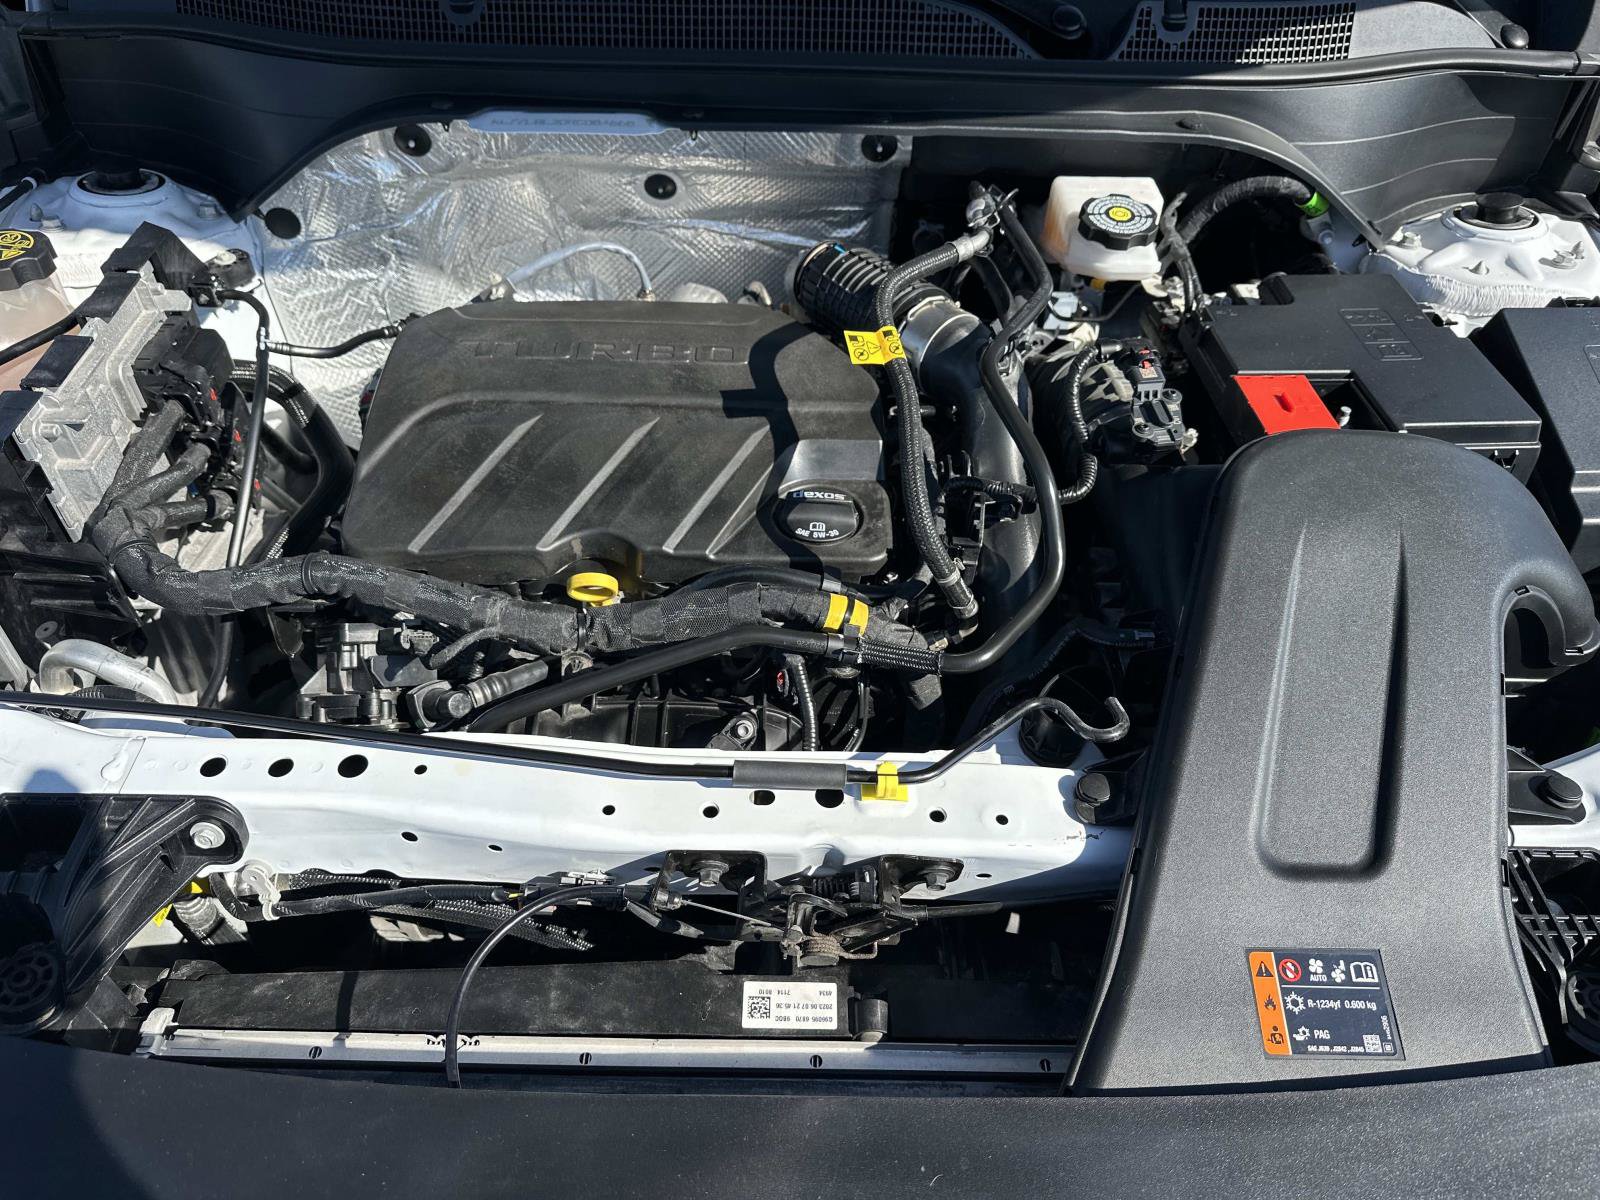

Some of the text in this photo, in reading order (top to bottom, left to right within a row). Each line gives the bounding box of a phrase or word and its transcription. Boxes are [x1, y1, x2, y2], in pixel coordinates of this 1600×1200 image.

[457, 340, 749, 364] TURBO
[792, 490, 847, 500] dexos
[795, 527, 840, 539] SAE 5W-30
[1309, 974, 1327, 982] AUTO
[1307, 999, 1377, 1011] R-1234yf 0.600 kg
[1313, 1029, 1331, 1039] PAG
